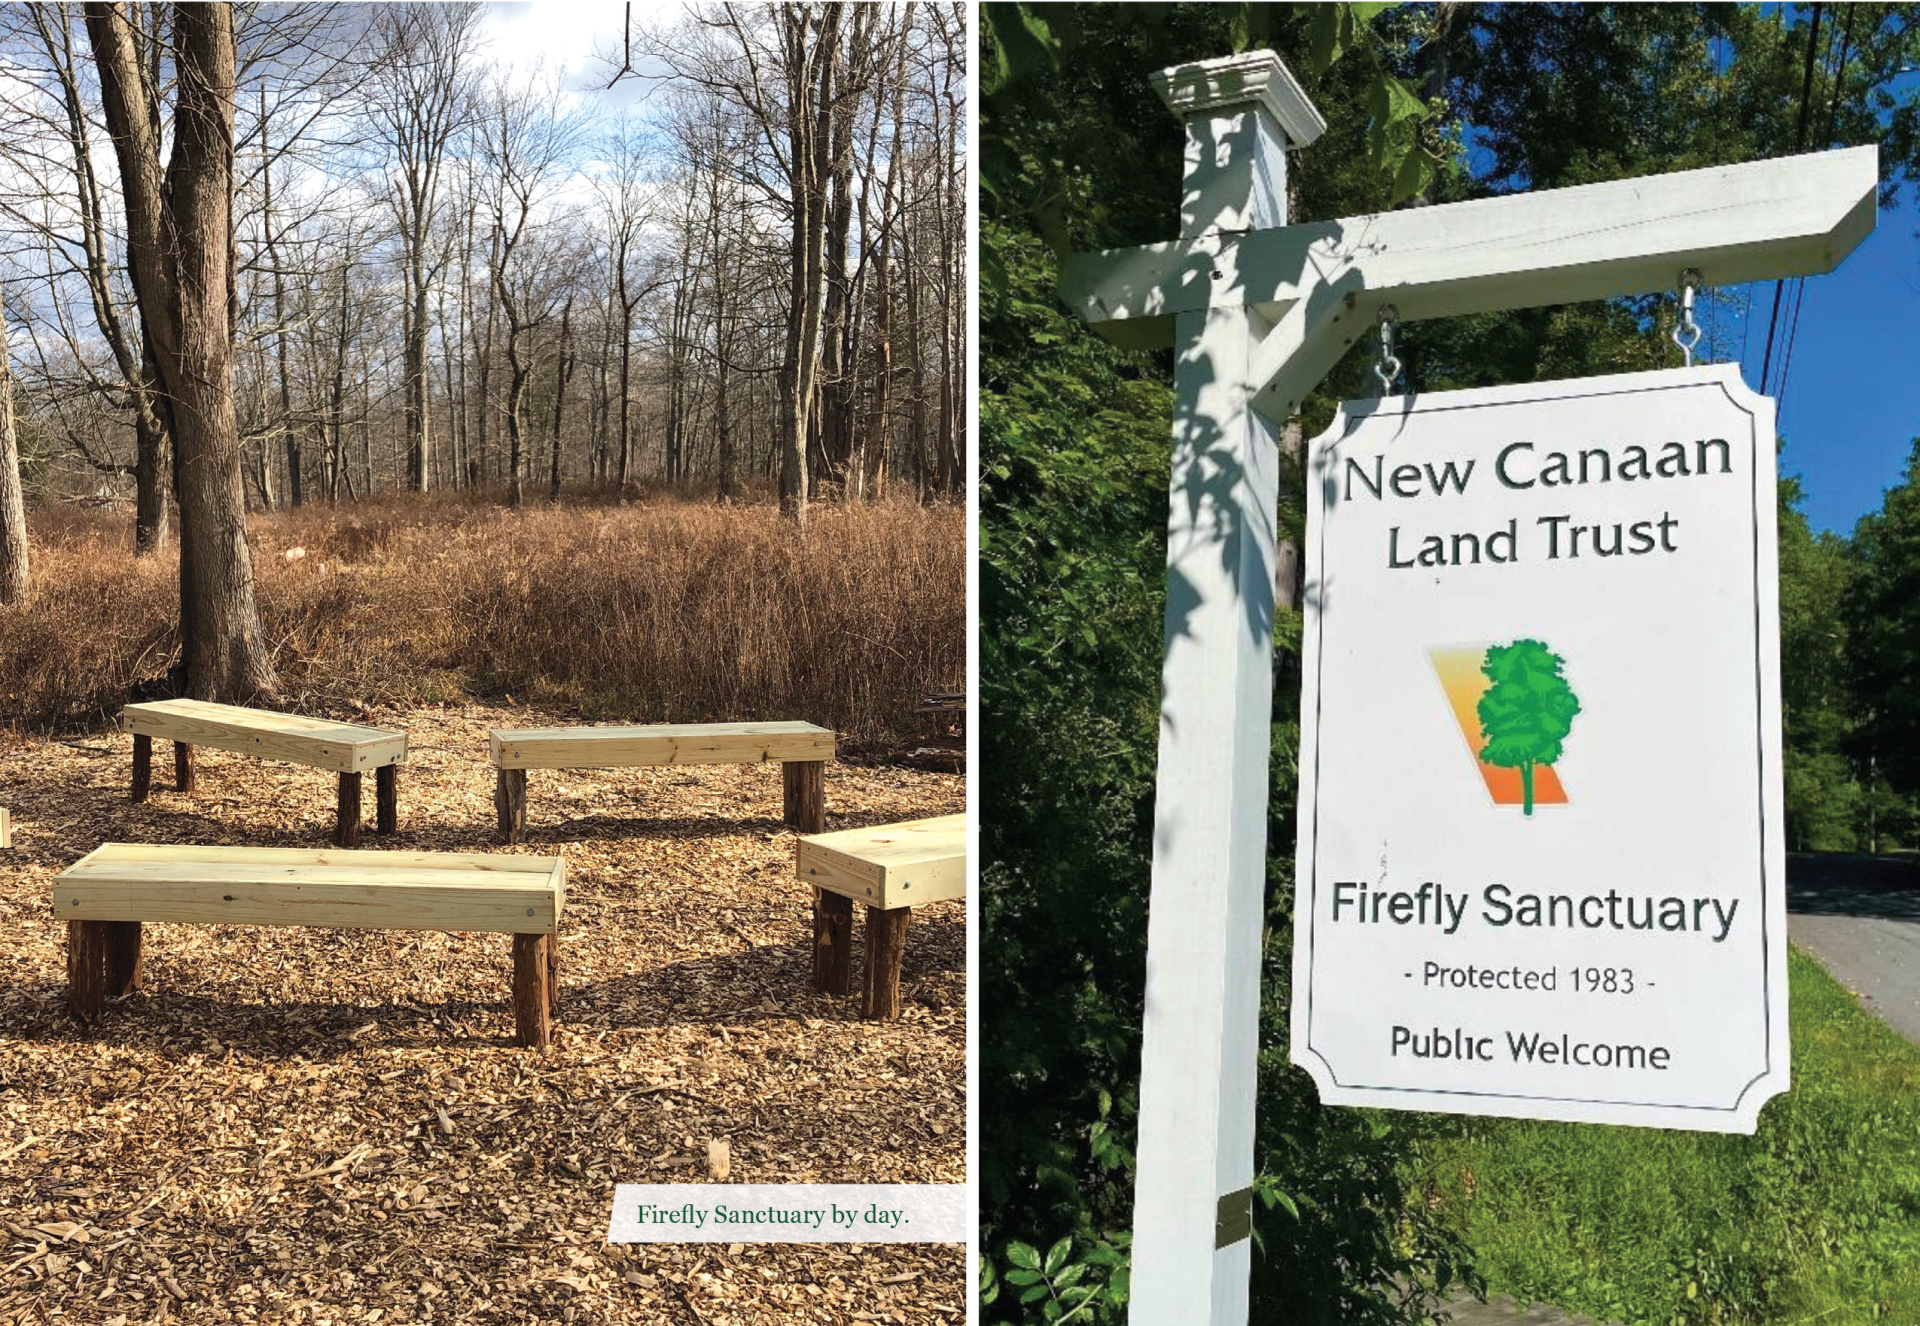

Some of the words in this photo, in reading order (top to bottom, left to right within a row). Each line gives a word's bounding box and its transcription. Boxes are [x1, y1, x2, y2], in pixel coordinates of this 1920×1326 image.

[1343, 454, 1476, 502] New
[1494, 437, 1734, 490] Canaan
[1387, 517, 1518, 569] Land
[1536, 511, 1679, 560] Trust
[1332, 881, 1469, 935] Firefly
[1481, 883, 1740, 943] Sanctuary
[1423, 961, 1557, 991] Protected
[1570, 967, 1635, 995] 1983
[1390, 1025, 1494, 1062] Public
[1505, 1031, 1671, 1070] Welcome
